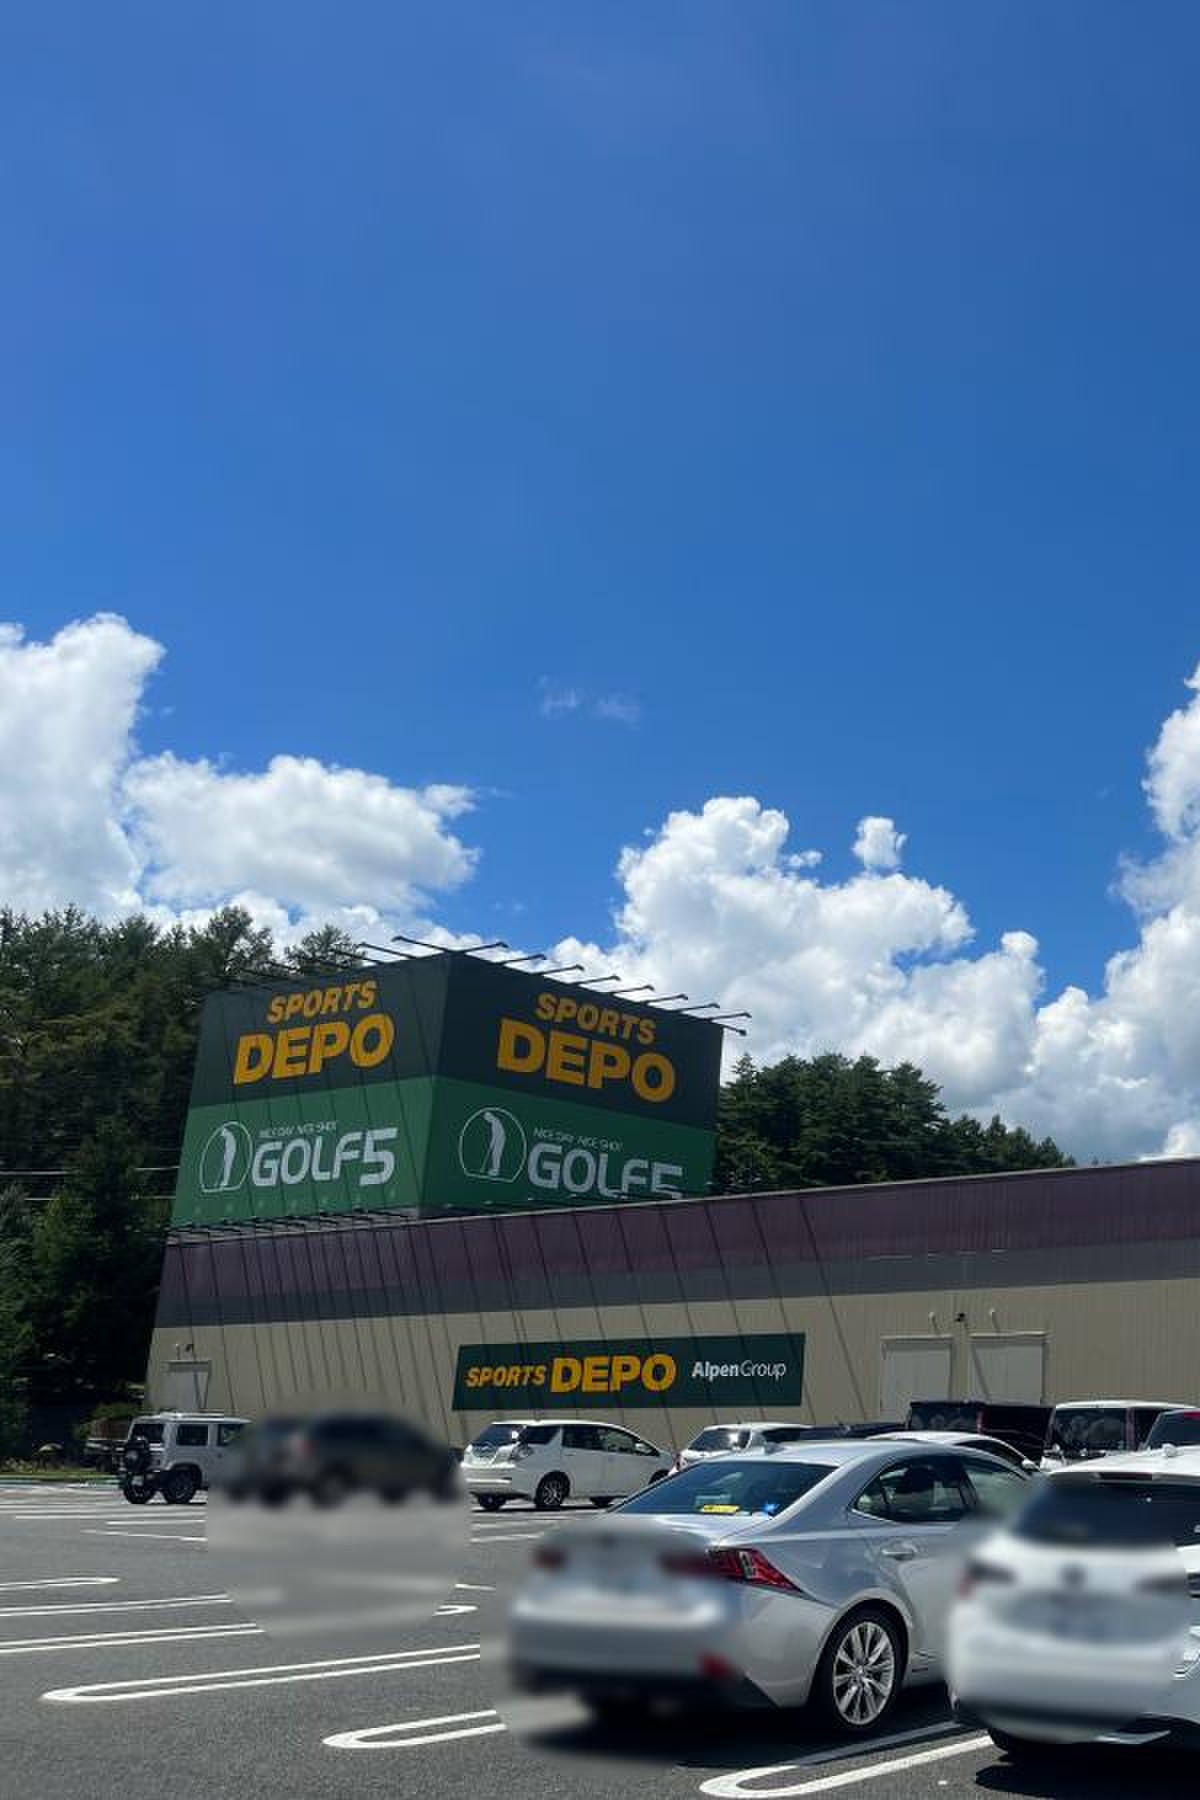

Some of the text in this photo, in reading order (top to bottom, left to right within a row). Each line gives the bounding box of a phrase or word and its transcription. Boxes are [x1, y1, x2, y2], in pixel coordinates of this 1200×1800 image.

[267, 980, 377, 1023] SPORTS
[535, 992, 657, 1045] SPORTS
[233, 1013, 394, 1085] DEPO
[497, 1016, 676, 1102] DEPO
[252, 1127, 398, 1187] GOLF5
[527, 1142, 684, 1199] GOLF5
[465, 1365, 547, 1388] SPORTS
[551, 1353, 677, 1393] DEPO
